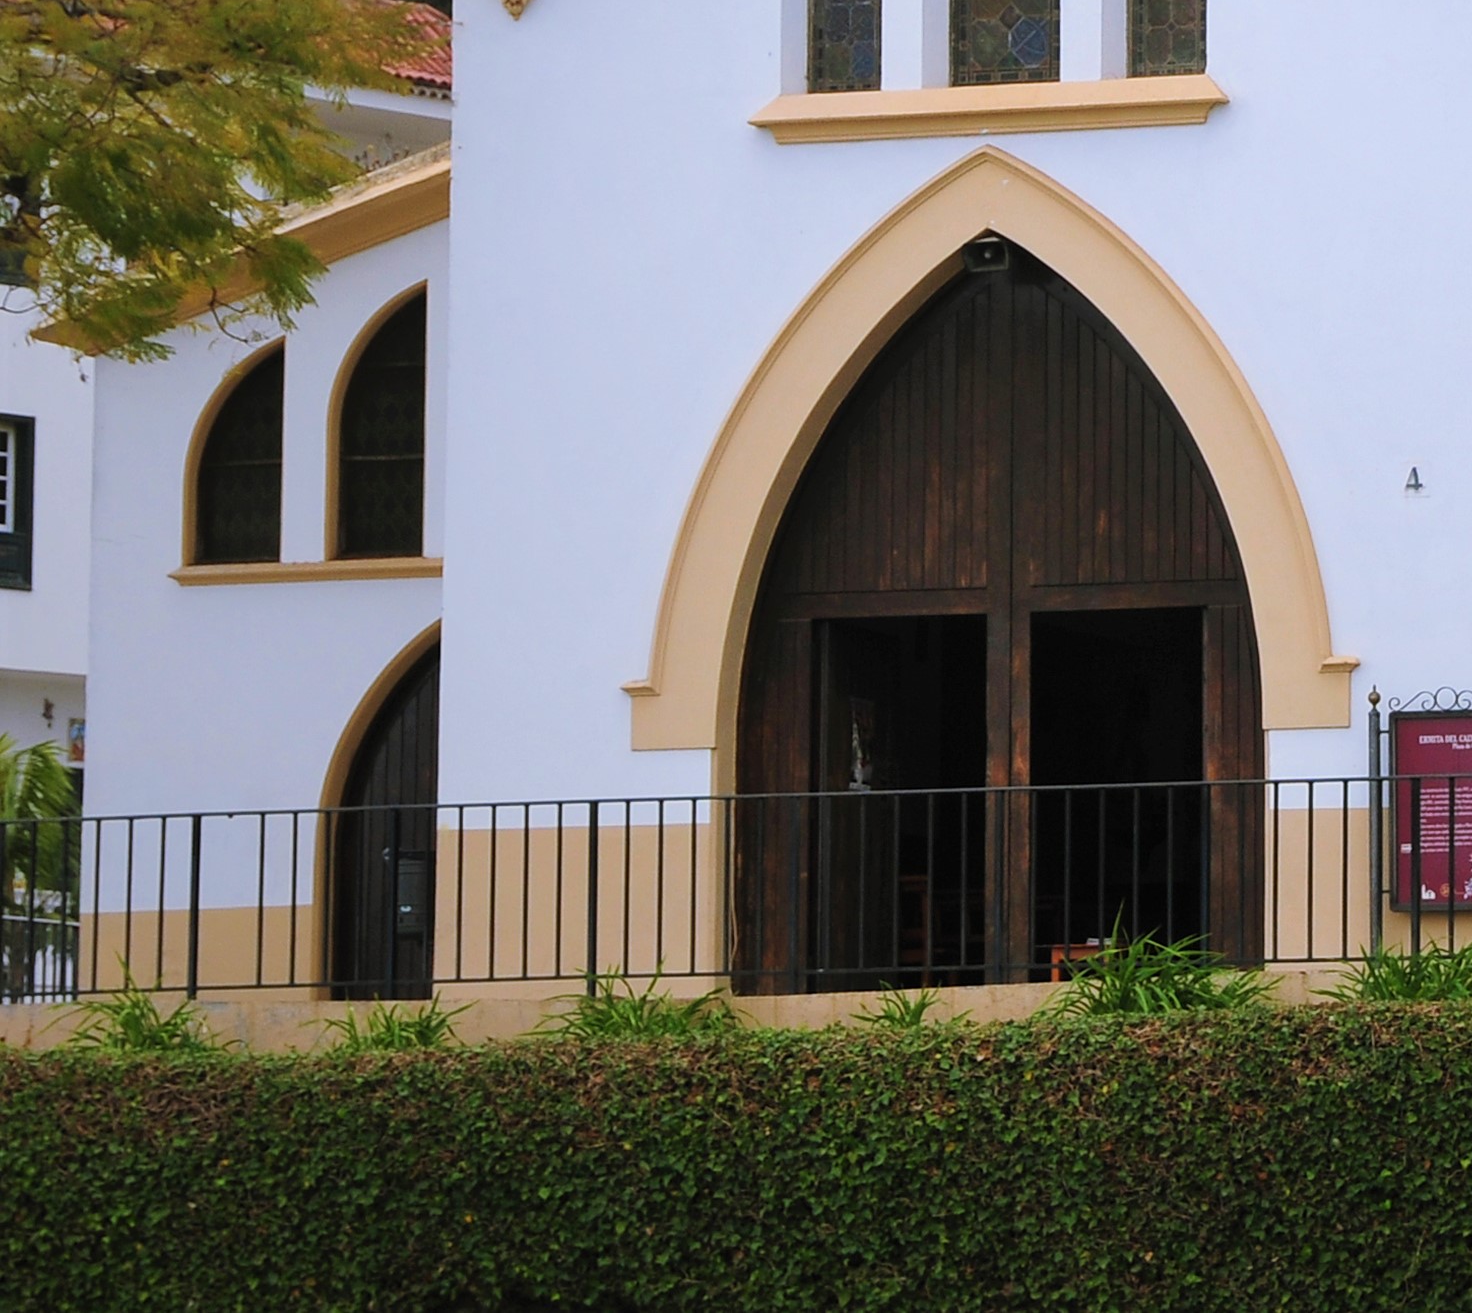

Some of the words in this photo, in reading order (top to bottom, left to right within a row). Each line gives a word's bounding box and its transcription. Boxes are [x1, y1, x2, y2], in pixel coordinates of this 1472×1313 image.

[1404, 466, 1423, 490] 4
[1419, 735, 1444, 744] ERMITA
[1445, 734, 1457, 743] DEL
